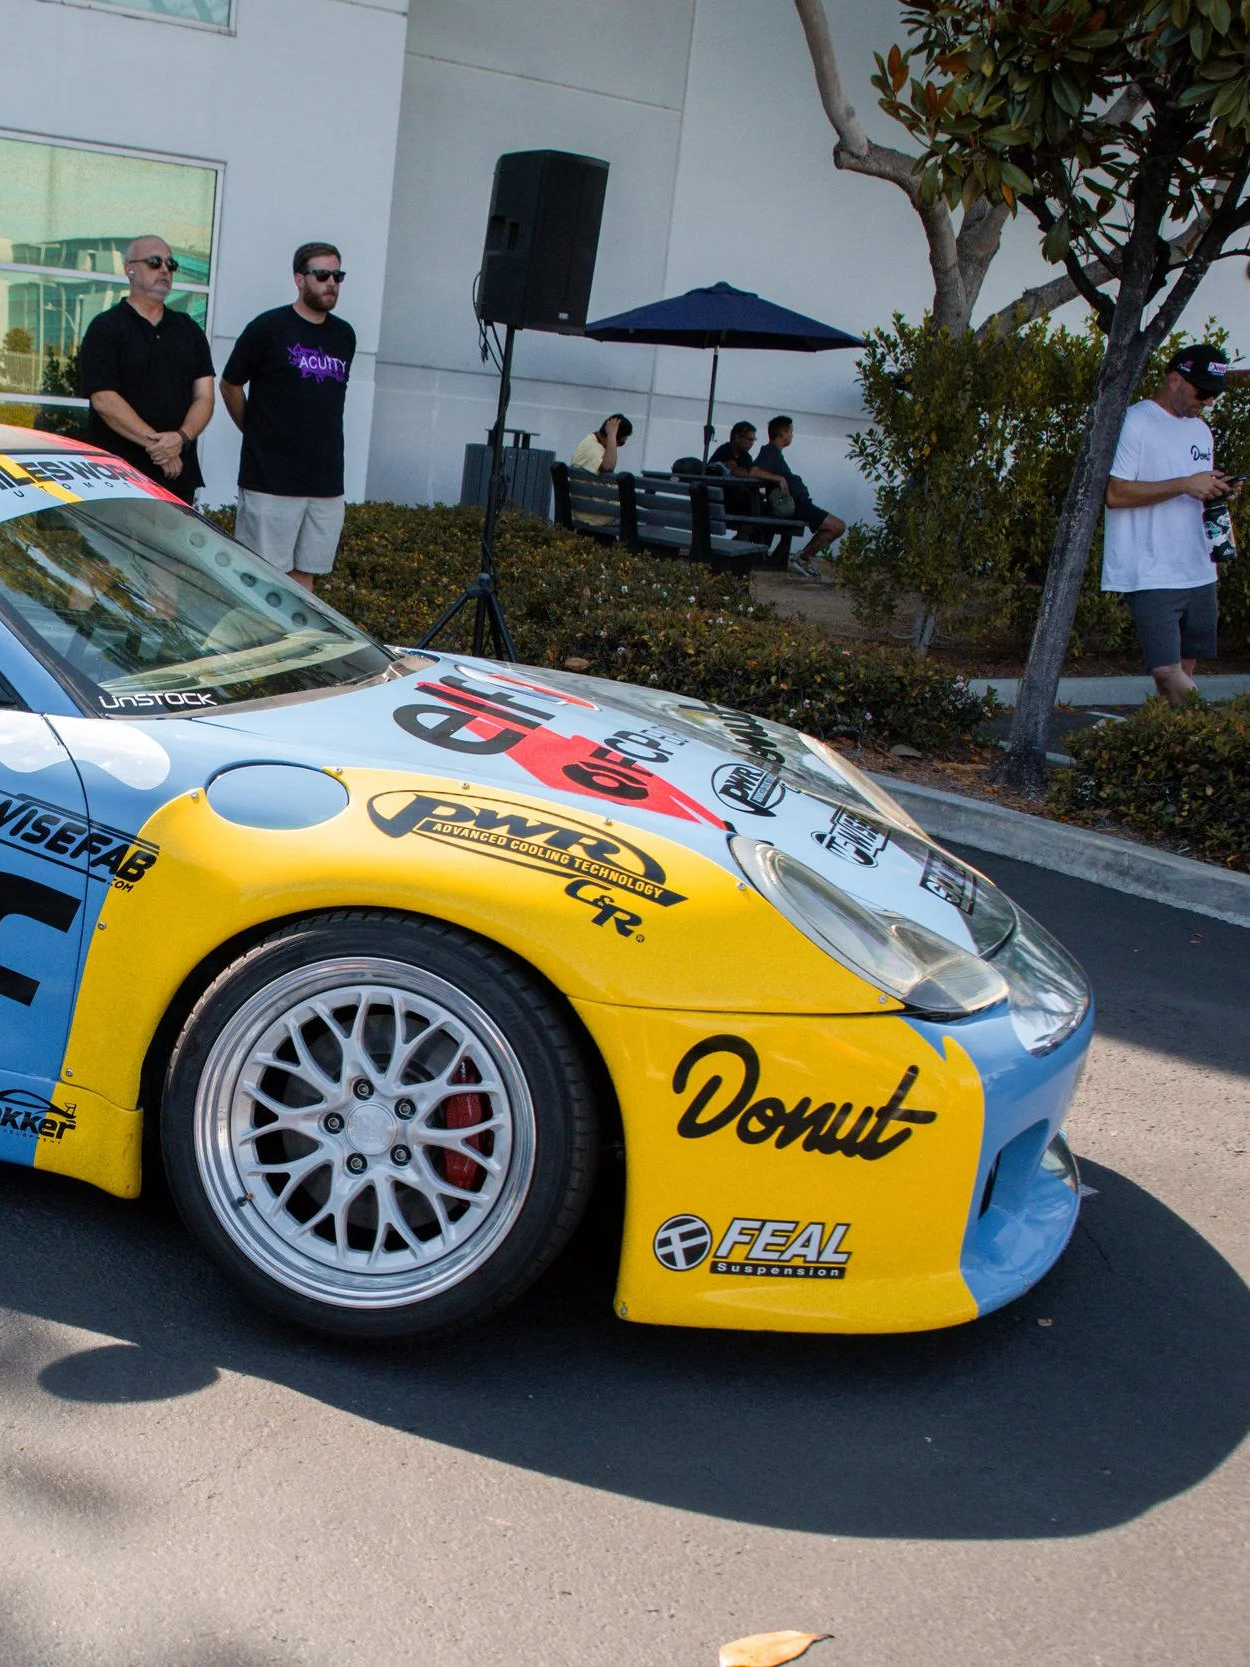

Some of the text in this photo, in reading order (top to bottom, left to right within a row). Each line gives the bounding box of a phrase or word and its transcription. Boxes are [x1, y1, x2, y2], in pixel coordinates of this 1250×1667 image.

[298, 355, 347, 373] ACUITY
[390, 793, 623, 869] PWR
[432, 821, 664, 900] ADVANCED COOLING TECHNOLOGY
[671, 1033, 938, 1161] Donut
[713, 1217, 852, 1264] FEAL
[716, 1262, 841, 1277] Suspension
